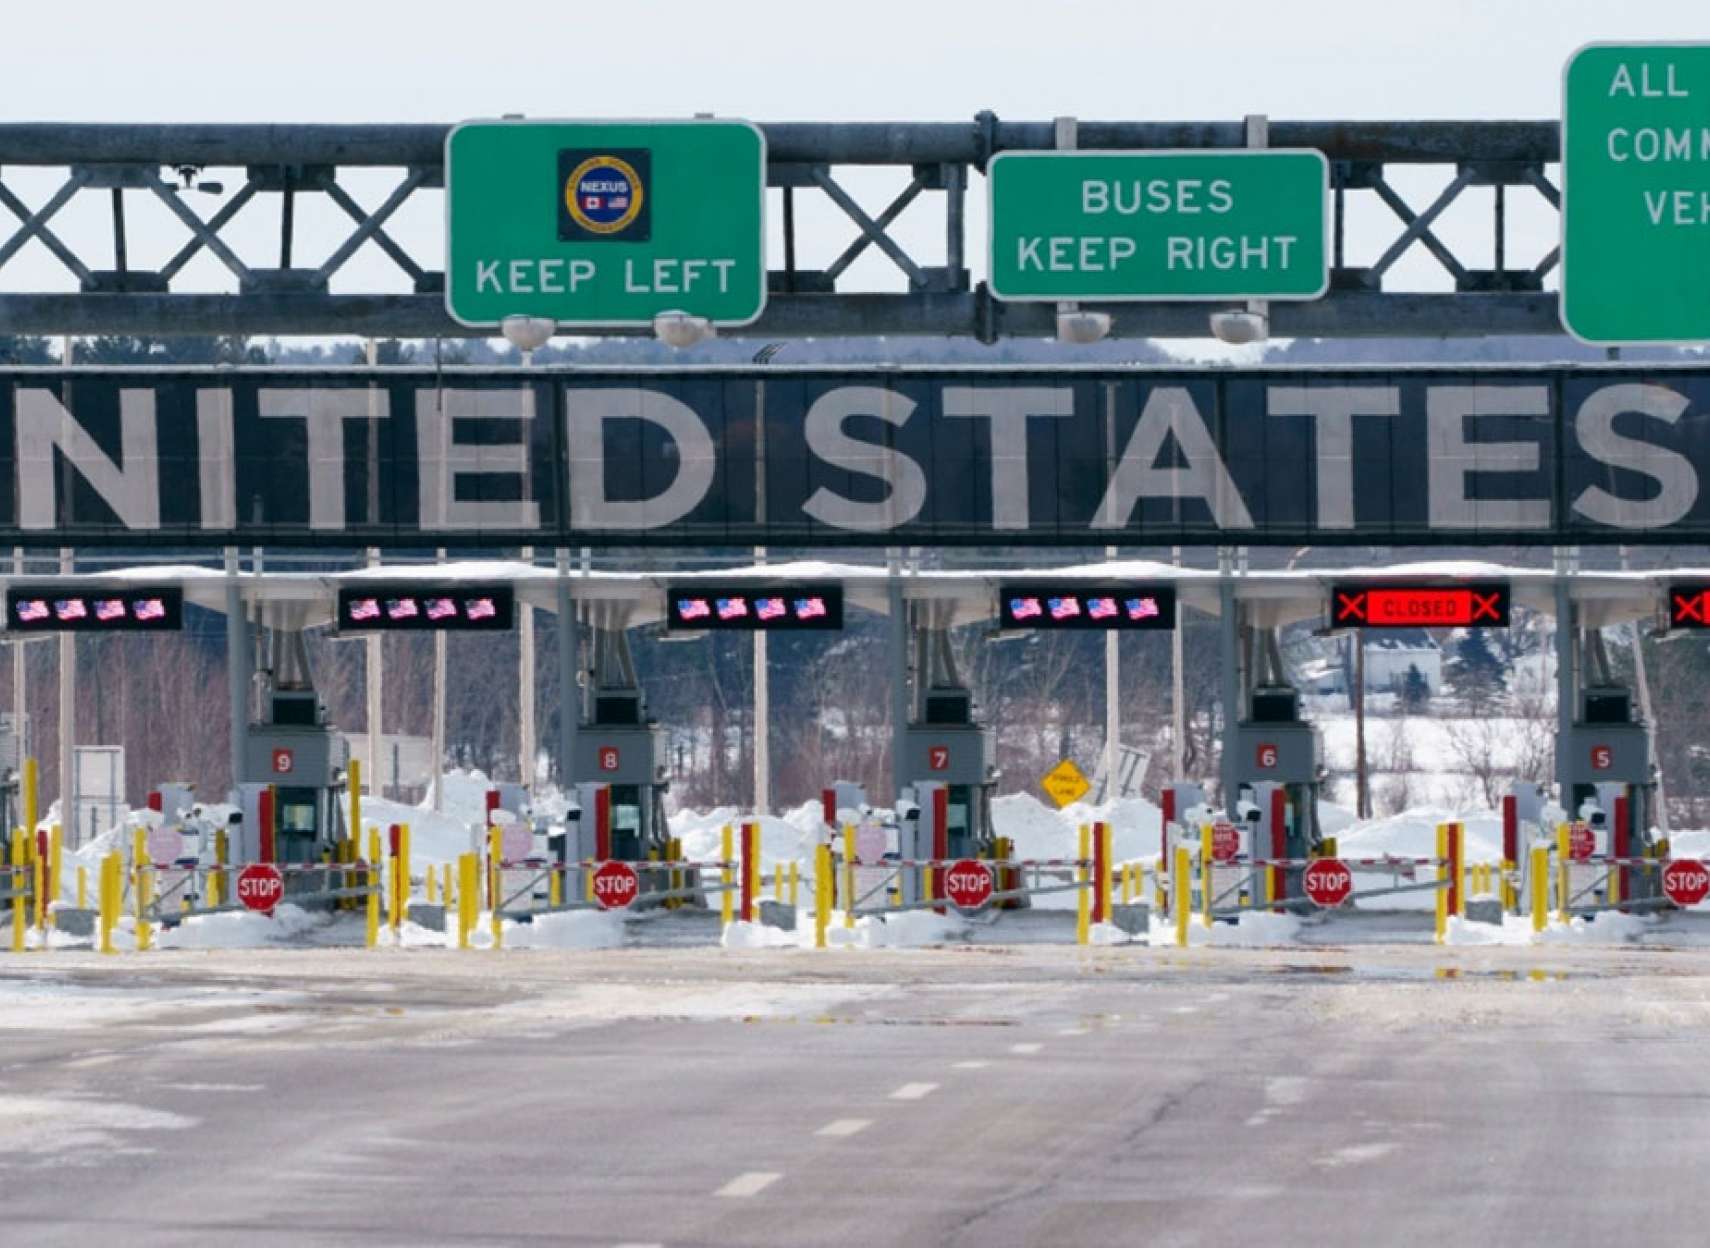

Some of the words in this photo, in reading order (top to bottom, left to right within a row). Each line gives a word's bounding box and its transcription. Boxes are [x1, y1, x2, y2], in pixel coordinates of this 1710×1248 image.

[1608, 62, 1689, 97] ALL
[581, 180, 629, 194] NEXUS
[1082, 180, 1234, 215] BUSES
[1018, 236, 1137, 271] KEEP
[1167, 236, 1298, 270] RIGHT
[475, 259, 596, 293] KEEP
[625, 258, 736, 293] LEFT
[802, 383, 1700, 532] STATES
[1382, 598, 1457, 617] CLOSED
[277, 752, 291, 772] 9
[604, 750, 617, 769] 8
[935, 750, 947, 768] 7
[1262, 749, 1276, 767] 6
[1596, 750, 1610, 768] 5
[238, 877, 280, 898] STOP
[595, 874, 634, 895] STOP
[948, 873, 990, 894] STOP
[1308, 872, 1349, 892] STOP
[1666, 872, 1708, 892] STOP
